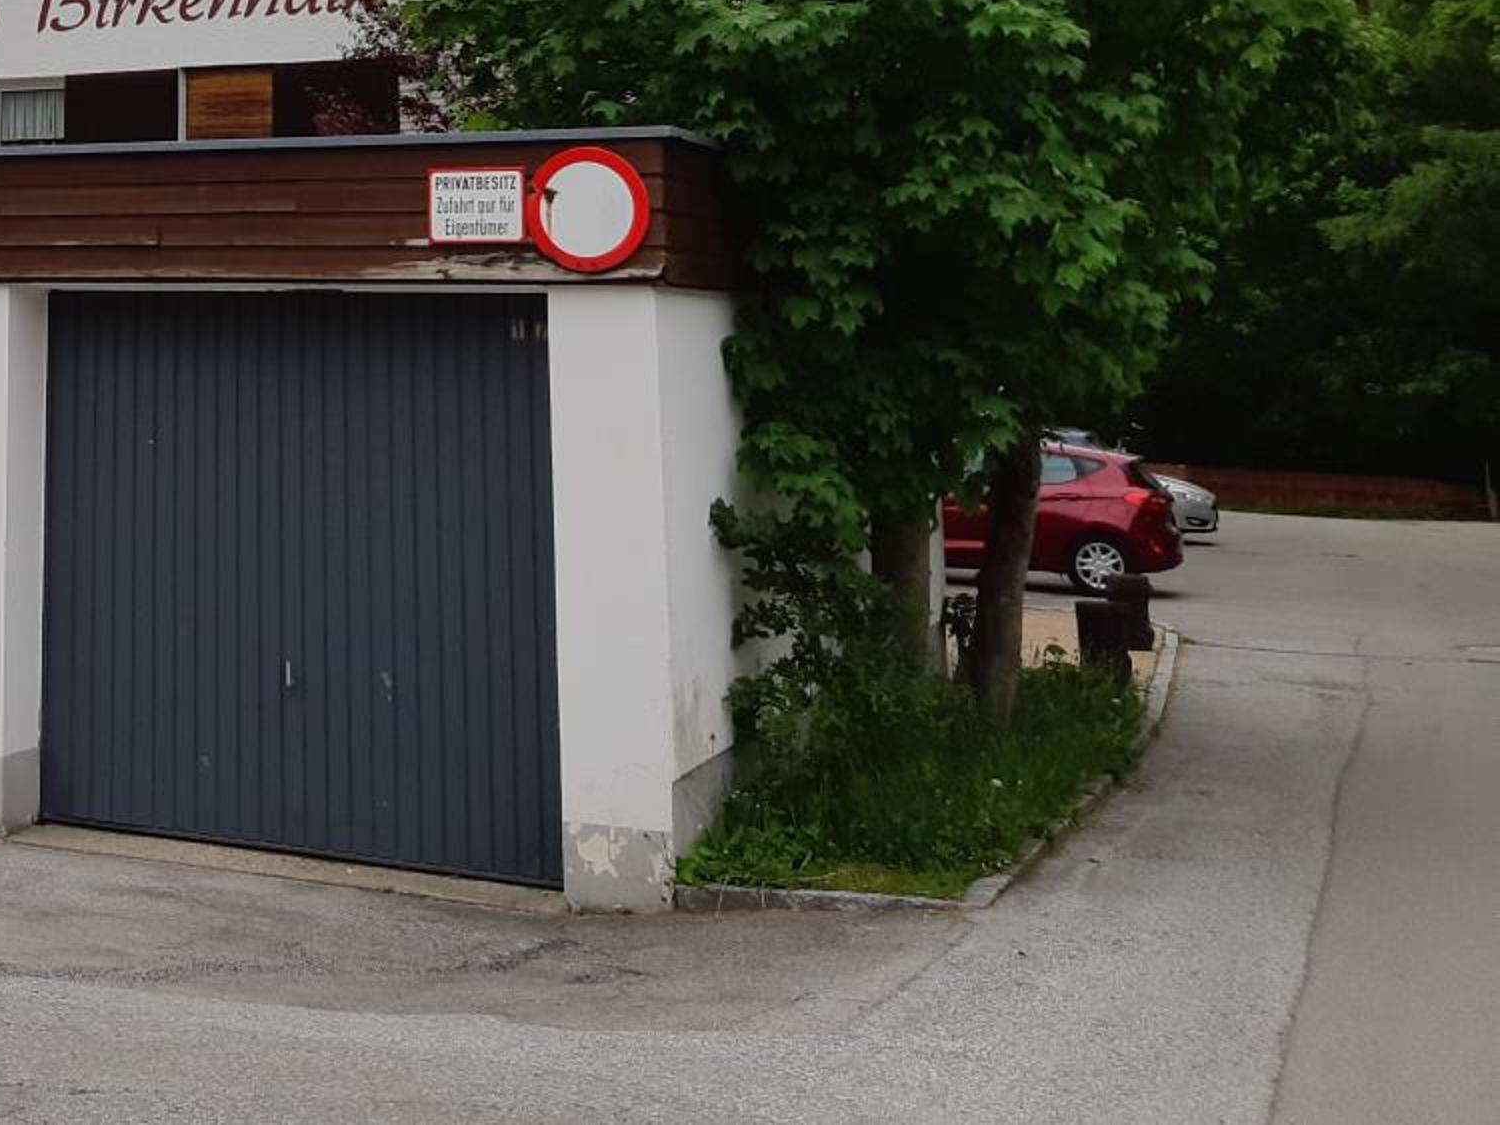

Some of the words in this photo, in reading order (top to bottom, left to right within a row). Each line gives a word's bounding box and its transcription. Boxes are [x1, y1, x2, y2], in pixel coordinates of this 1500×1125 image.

[435, 176, 517, 191] PRIVATBESITZ
[436, 196, 475, 214] Zufahrt
[477, 199, 497, 214] nur
[498, 194, 515, 213] für
[445, 218, 509, 238] Eigentümer
